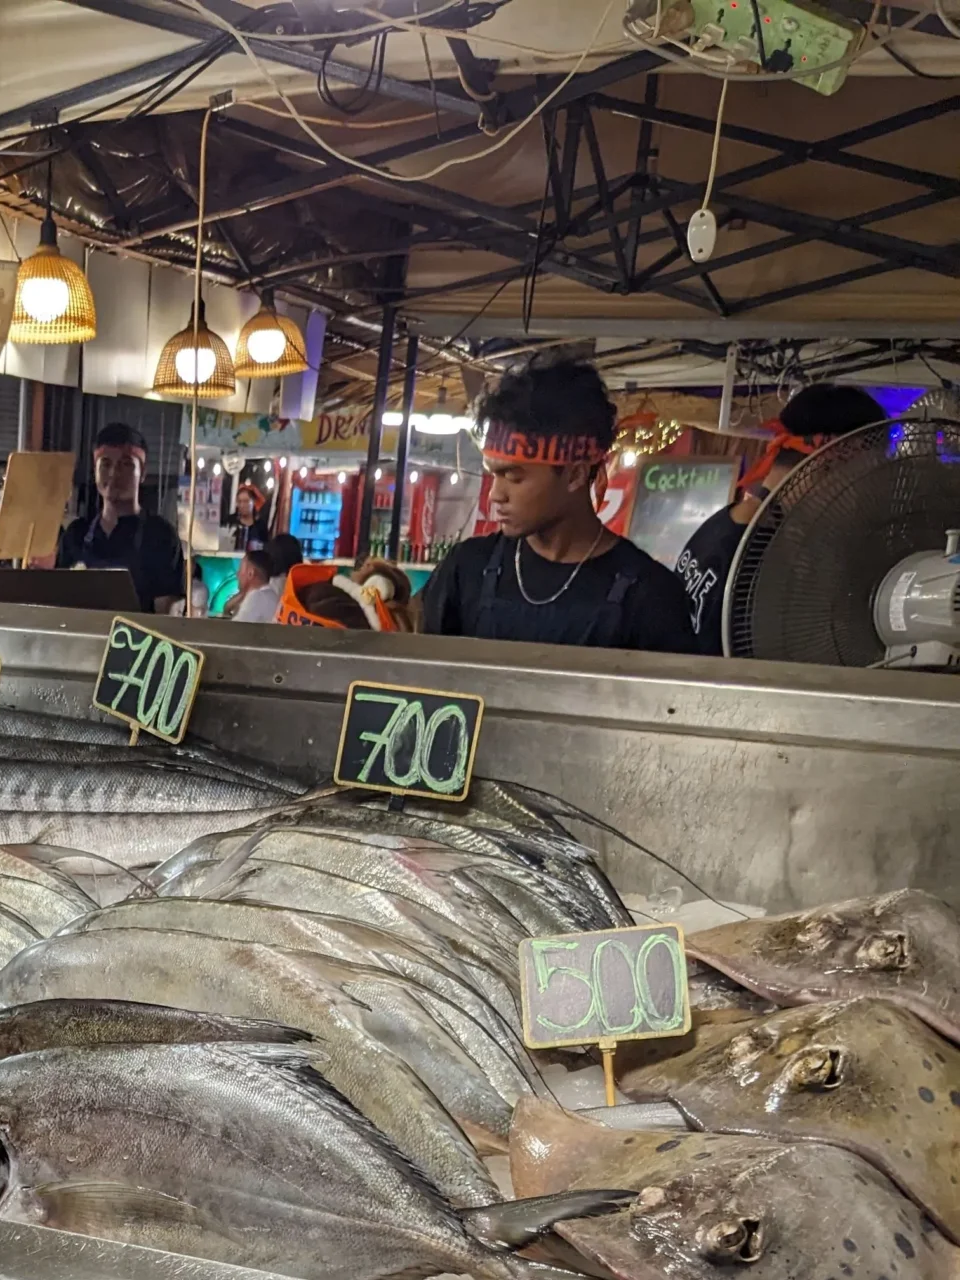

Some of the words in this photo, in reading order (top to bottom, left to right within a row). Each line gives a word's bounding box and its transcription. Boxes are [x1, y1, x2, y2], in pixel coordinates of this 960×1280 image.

[108, 626, 198, 735] 700
[354, 692, 469, 794] 700
[531, 934, 684, 1035] 500
